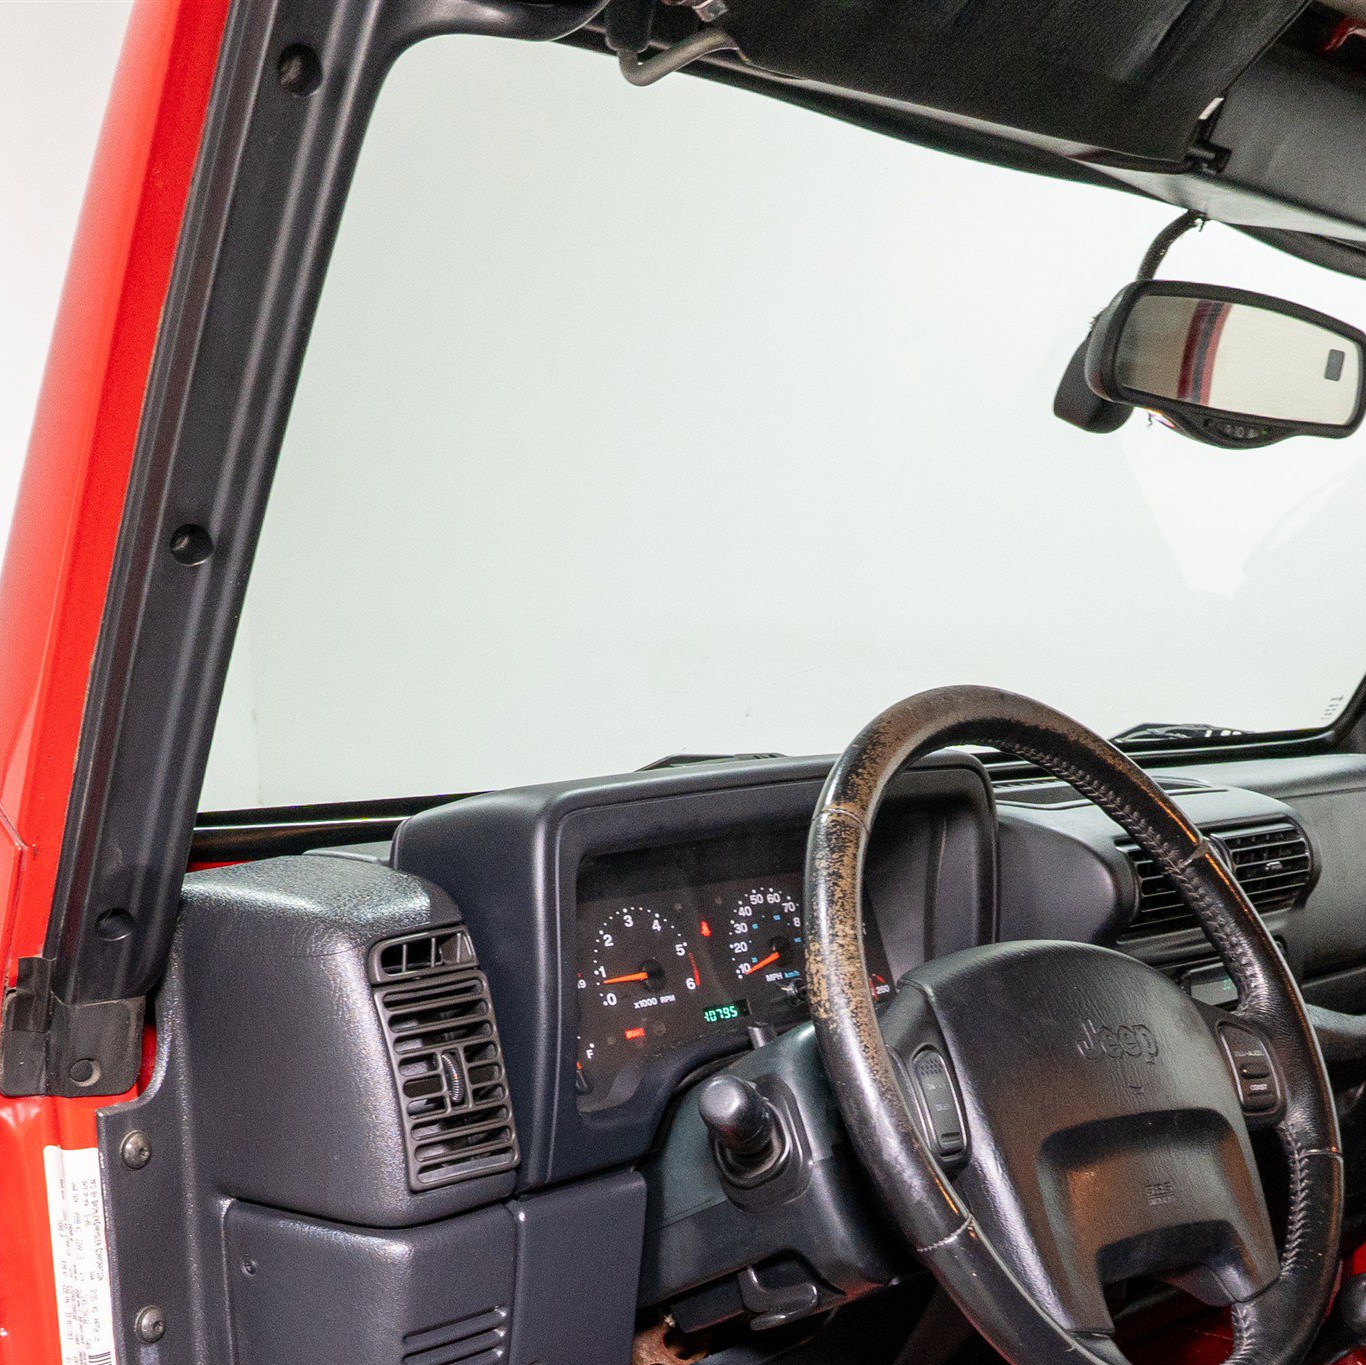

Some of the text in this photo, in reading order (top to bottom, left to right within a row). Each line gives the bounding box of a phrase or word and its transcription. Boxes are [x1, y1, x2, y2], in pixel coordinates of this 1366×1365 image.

[750, 893, 764, 905] 50
[767, 893, 781, 904] 60
[738, 906, 752, 917] 40
[782, 902, 796, 913] 70
[623, 915, 634, 928] 3
[652, 919, 661, 931] 4
[734, 922, 748, 934] 30
[603, 934, 614, 947] 2
[675, 944, 685, 956] 5
[734, 942, 748, 953] 20
[599, 966, 606, 978] 1
[738, 963, 751, 974] 10
[765, 972, 783, 982] MPH
[686, 978, 696, 990] 6
[606, 993, 617, 1006] 0
[660, 994, 676, 1004] RPM
[1076, 1018, 1159, 1065] Jeep
[586, 1049, 594, 1060] F
